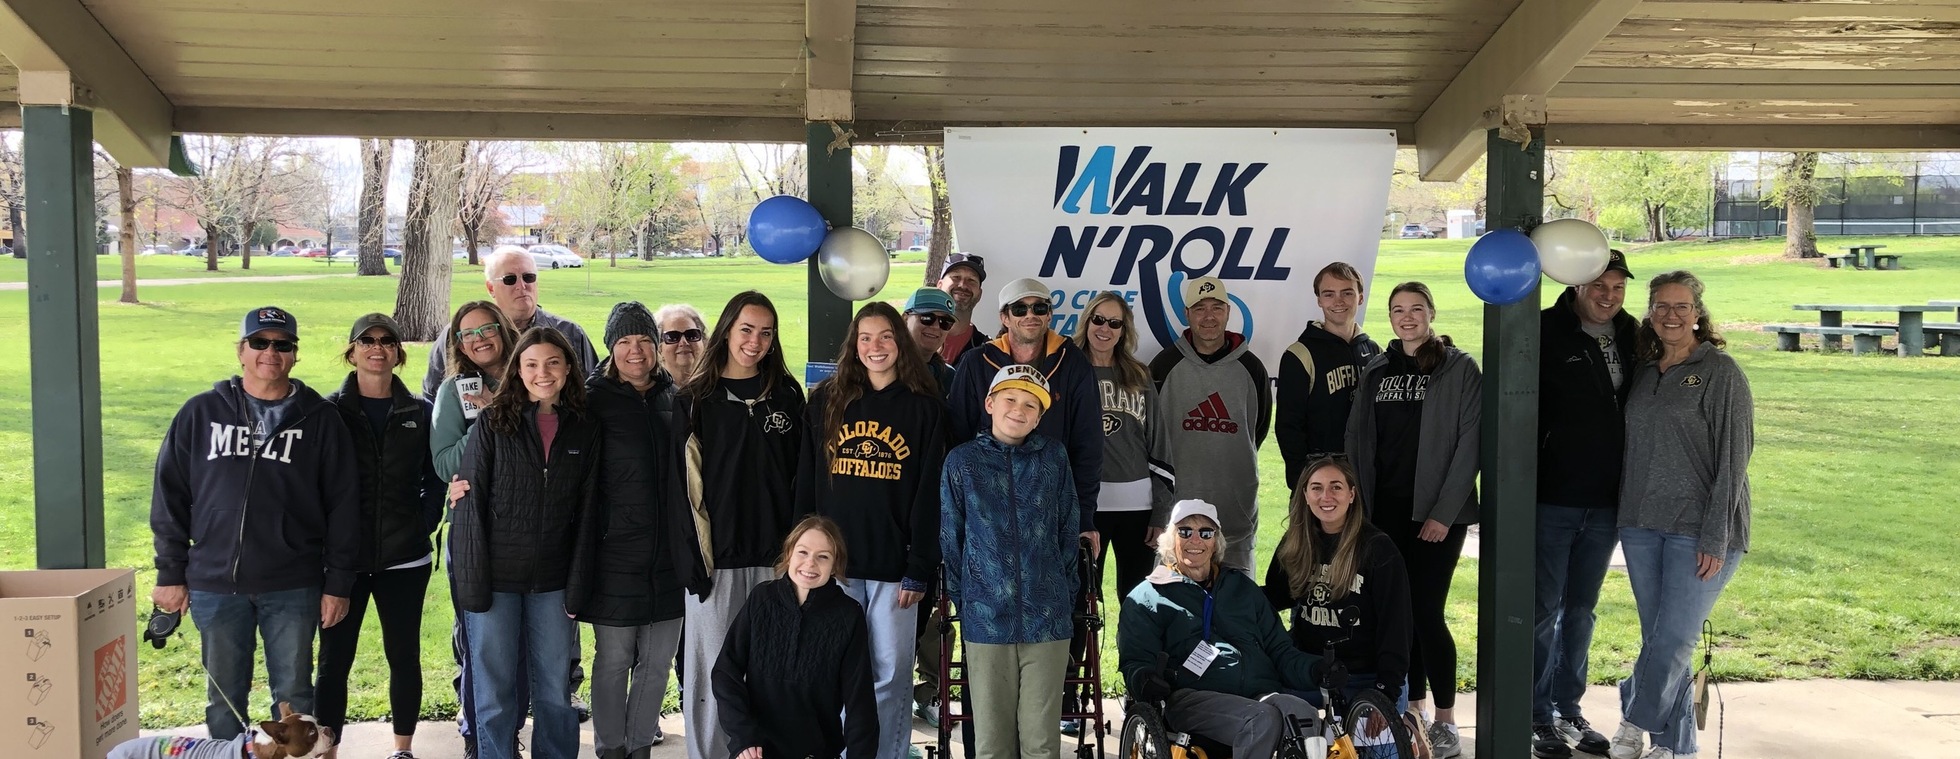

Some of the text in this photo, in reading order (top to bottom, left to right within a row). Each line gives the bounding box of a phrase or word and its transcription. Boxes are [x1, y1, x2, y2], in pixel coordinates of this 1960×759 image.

[1053, 145, 1269, 216] WALK
[1050, 289, 1138, 310] O CE
[1007, 366, 1046, 386] DENVER
[461, 382, 478, 392] TAKE
[1182, 416, 1239, 434] adidas
[832, 457, 902, 480] BUFFALOES
